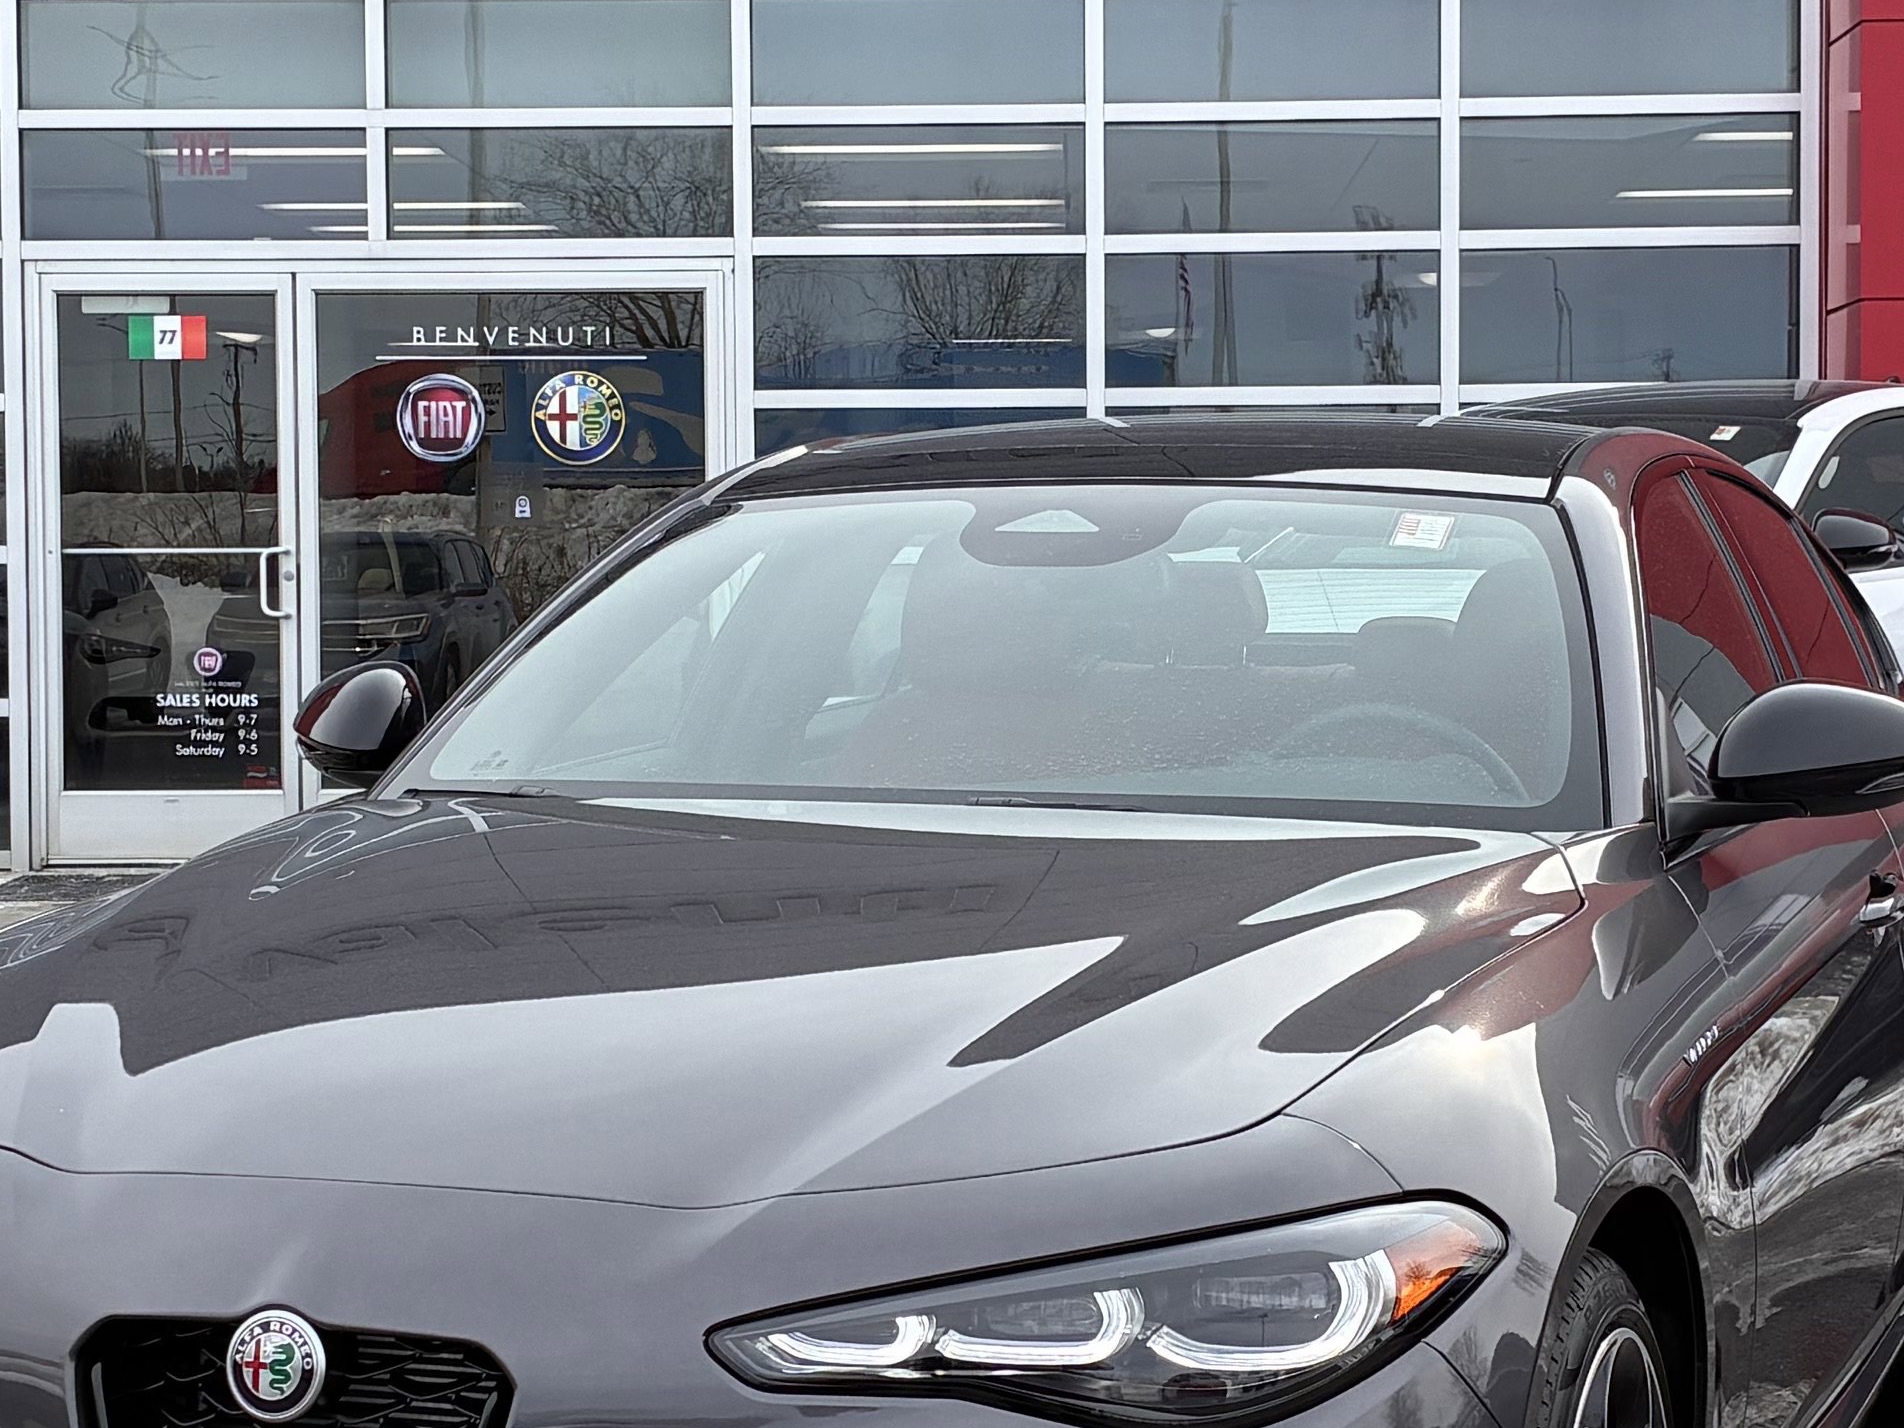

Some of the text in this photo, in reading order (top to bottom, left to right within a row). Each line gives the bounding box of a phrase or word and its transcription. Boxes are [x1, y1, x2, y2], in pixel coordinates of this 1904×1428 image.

[159, 329, 178, 345] 77
[411, 326, 610, 346] BENVENUTI
[535, 375, 567, 421] ALFA
[573, 374, 623, 422] ROMEO
[416, 400, 468, 439] FIAT
[156, 693, 259, 707] SALES HOURS
[175, 744, 225, 757] Saturday
[235, 1321, 314, 1370] ALFA ROMEO
